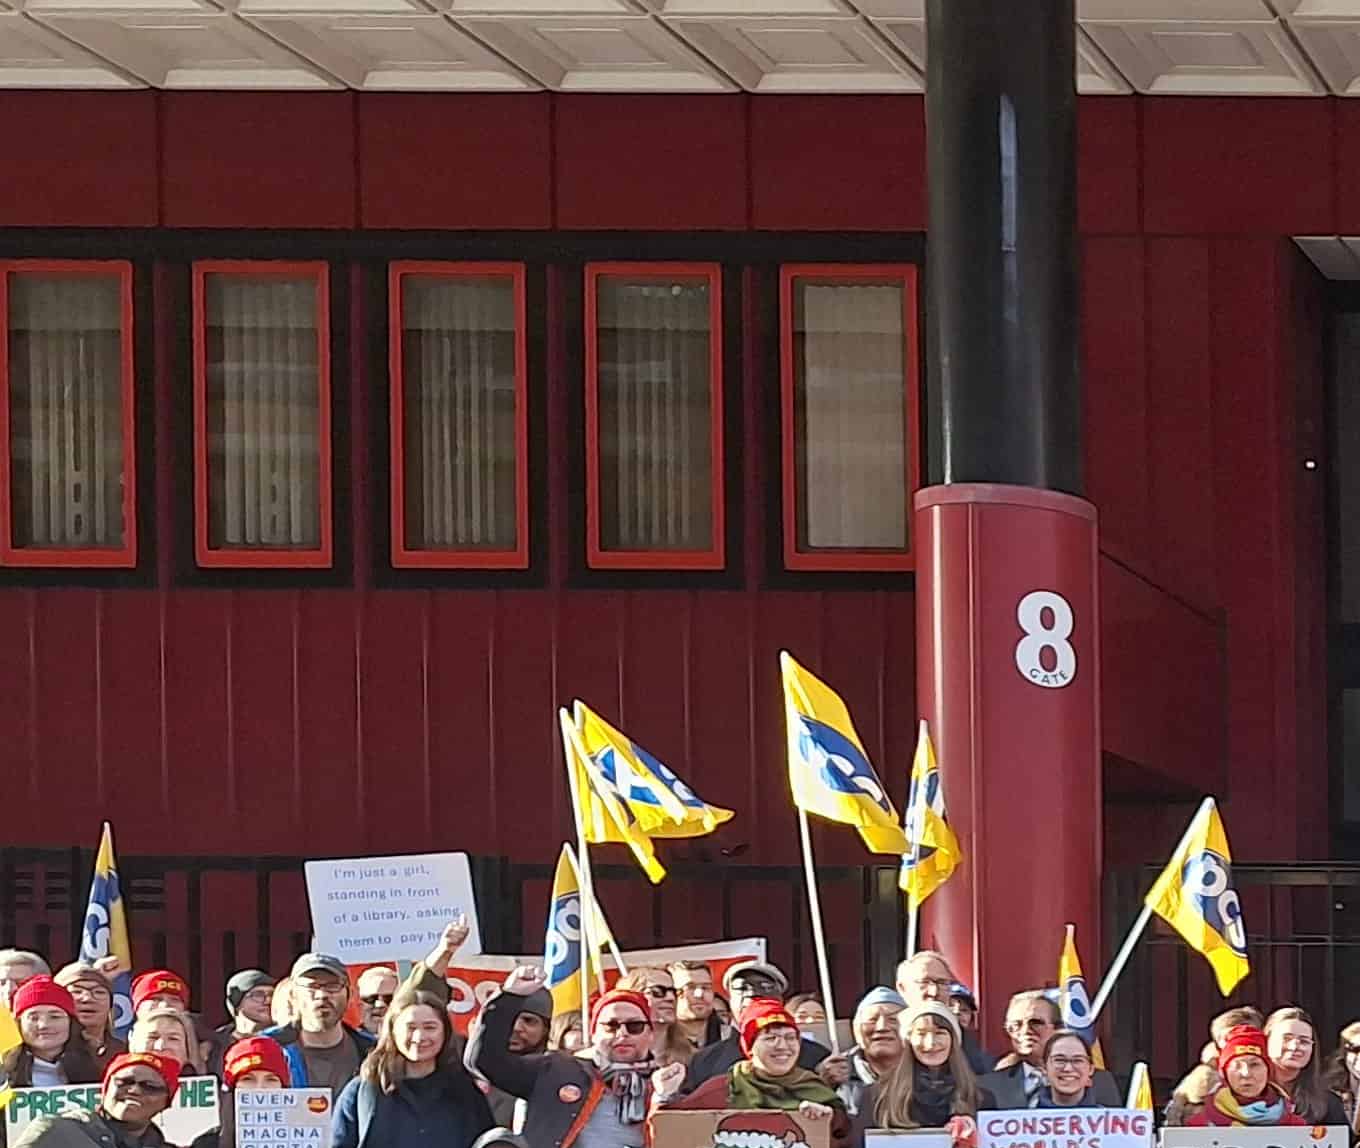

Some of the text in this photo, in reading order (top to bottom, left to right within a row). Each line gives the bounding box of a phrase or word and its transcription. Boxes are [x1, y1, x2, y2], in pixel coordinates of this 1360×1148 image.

[1016, 591, 1077, 688] 8
[1029, 668, 1068, 684] GATE
[333, 864, 430, 881] I'm just a girl,
[327, 886, 441, 902] standing in front
[333, 913, 347, 925] of
[350, 913, 360, 923] a
[415, 905, 461, 919] asking
[338, 931, 424, 949] them to pay
[180, 1080, 215, 1108] HE
[241, 1093, 295, 1105] EVEN
[242, 1111, 283, 1123] THE
[243, 1127, 320, 1139] MAGNA
